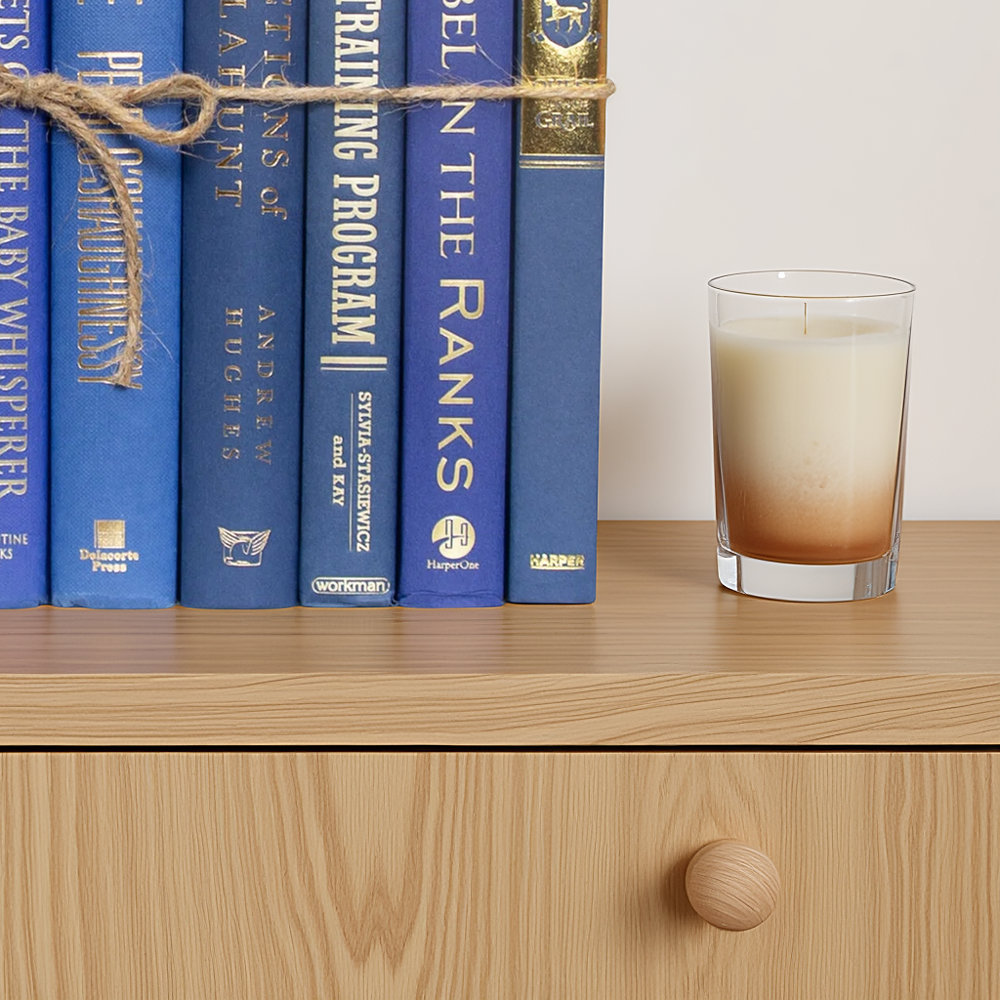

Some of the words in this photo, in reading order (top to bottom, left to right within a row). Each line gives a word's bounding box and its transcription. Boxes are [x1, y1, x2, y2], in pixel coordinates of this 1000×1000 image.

[260, 186, 287, 221] of
[440, 152, 475, 259] THE
[331, 174, 380, 345] PROGRAM
[222, 307, 243, 460] HUGHES
[255, 305, 275, 464] ANDREW
[437, 278, 485, 492] RANKS
[332, 435, 346, 469] and
[332, 474, 346, 506] KAY
[92, 561, 127, 573] Press
[426, 559, 480, 571] HarperOne
[316, 580, 386, 593] workman
